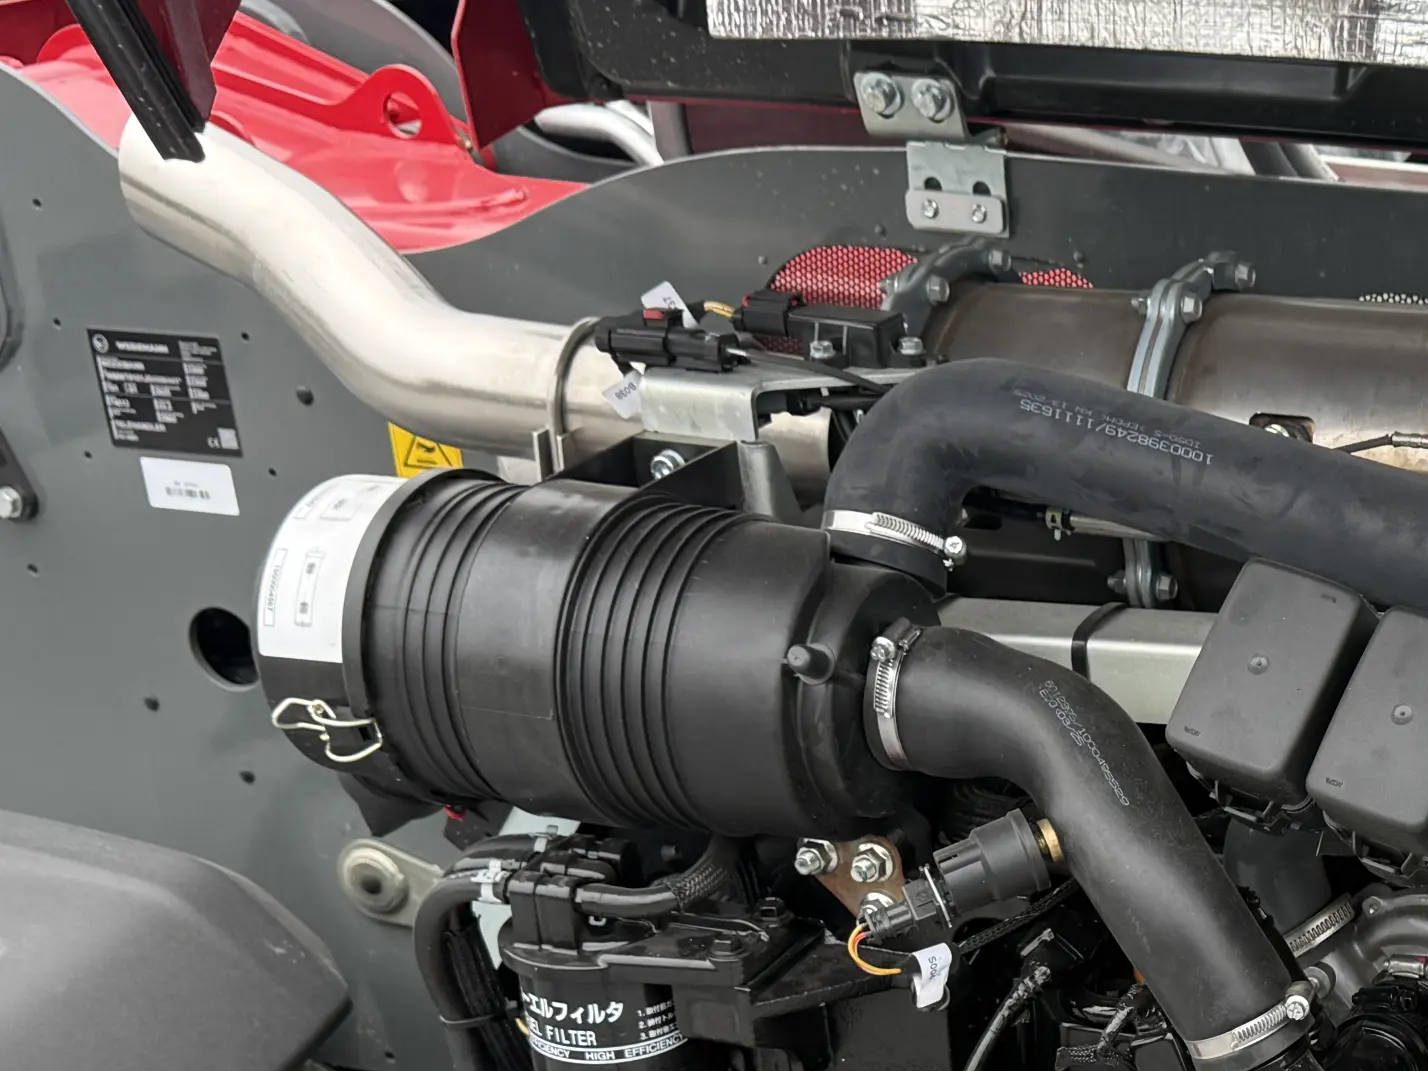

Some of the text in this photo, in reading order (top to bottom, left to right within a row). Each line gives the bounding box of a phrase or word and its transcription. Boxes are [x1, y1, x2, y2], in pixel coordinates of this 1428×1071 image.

[1019, 399, 1214, 465] 1000398249/1111635
[545, 1025, 597, 1046] FILTER
[585, 1051, 616, 1061] HIGH
[624, 1033, 685, 1059] EFFICIENCY
